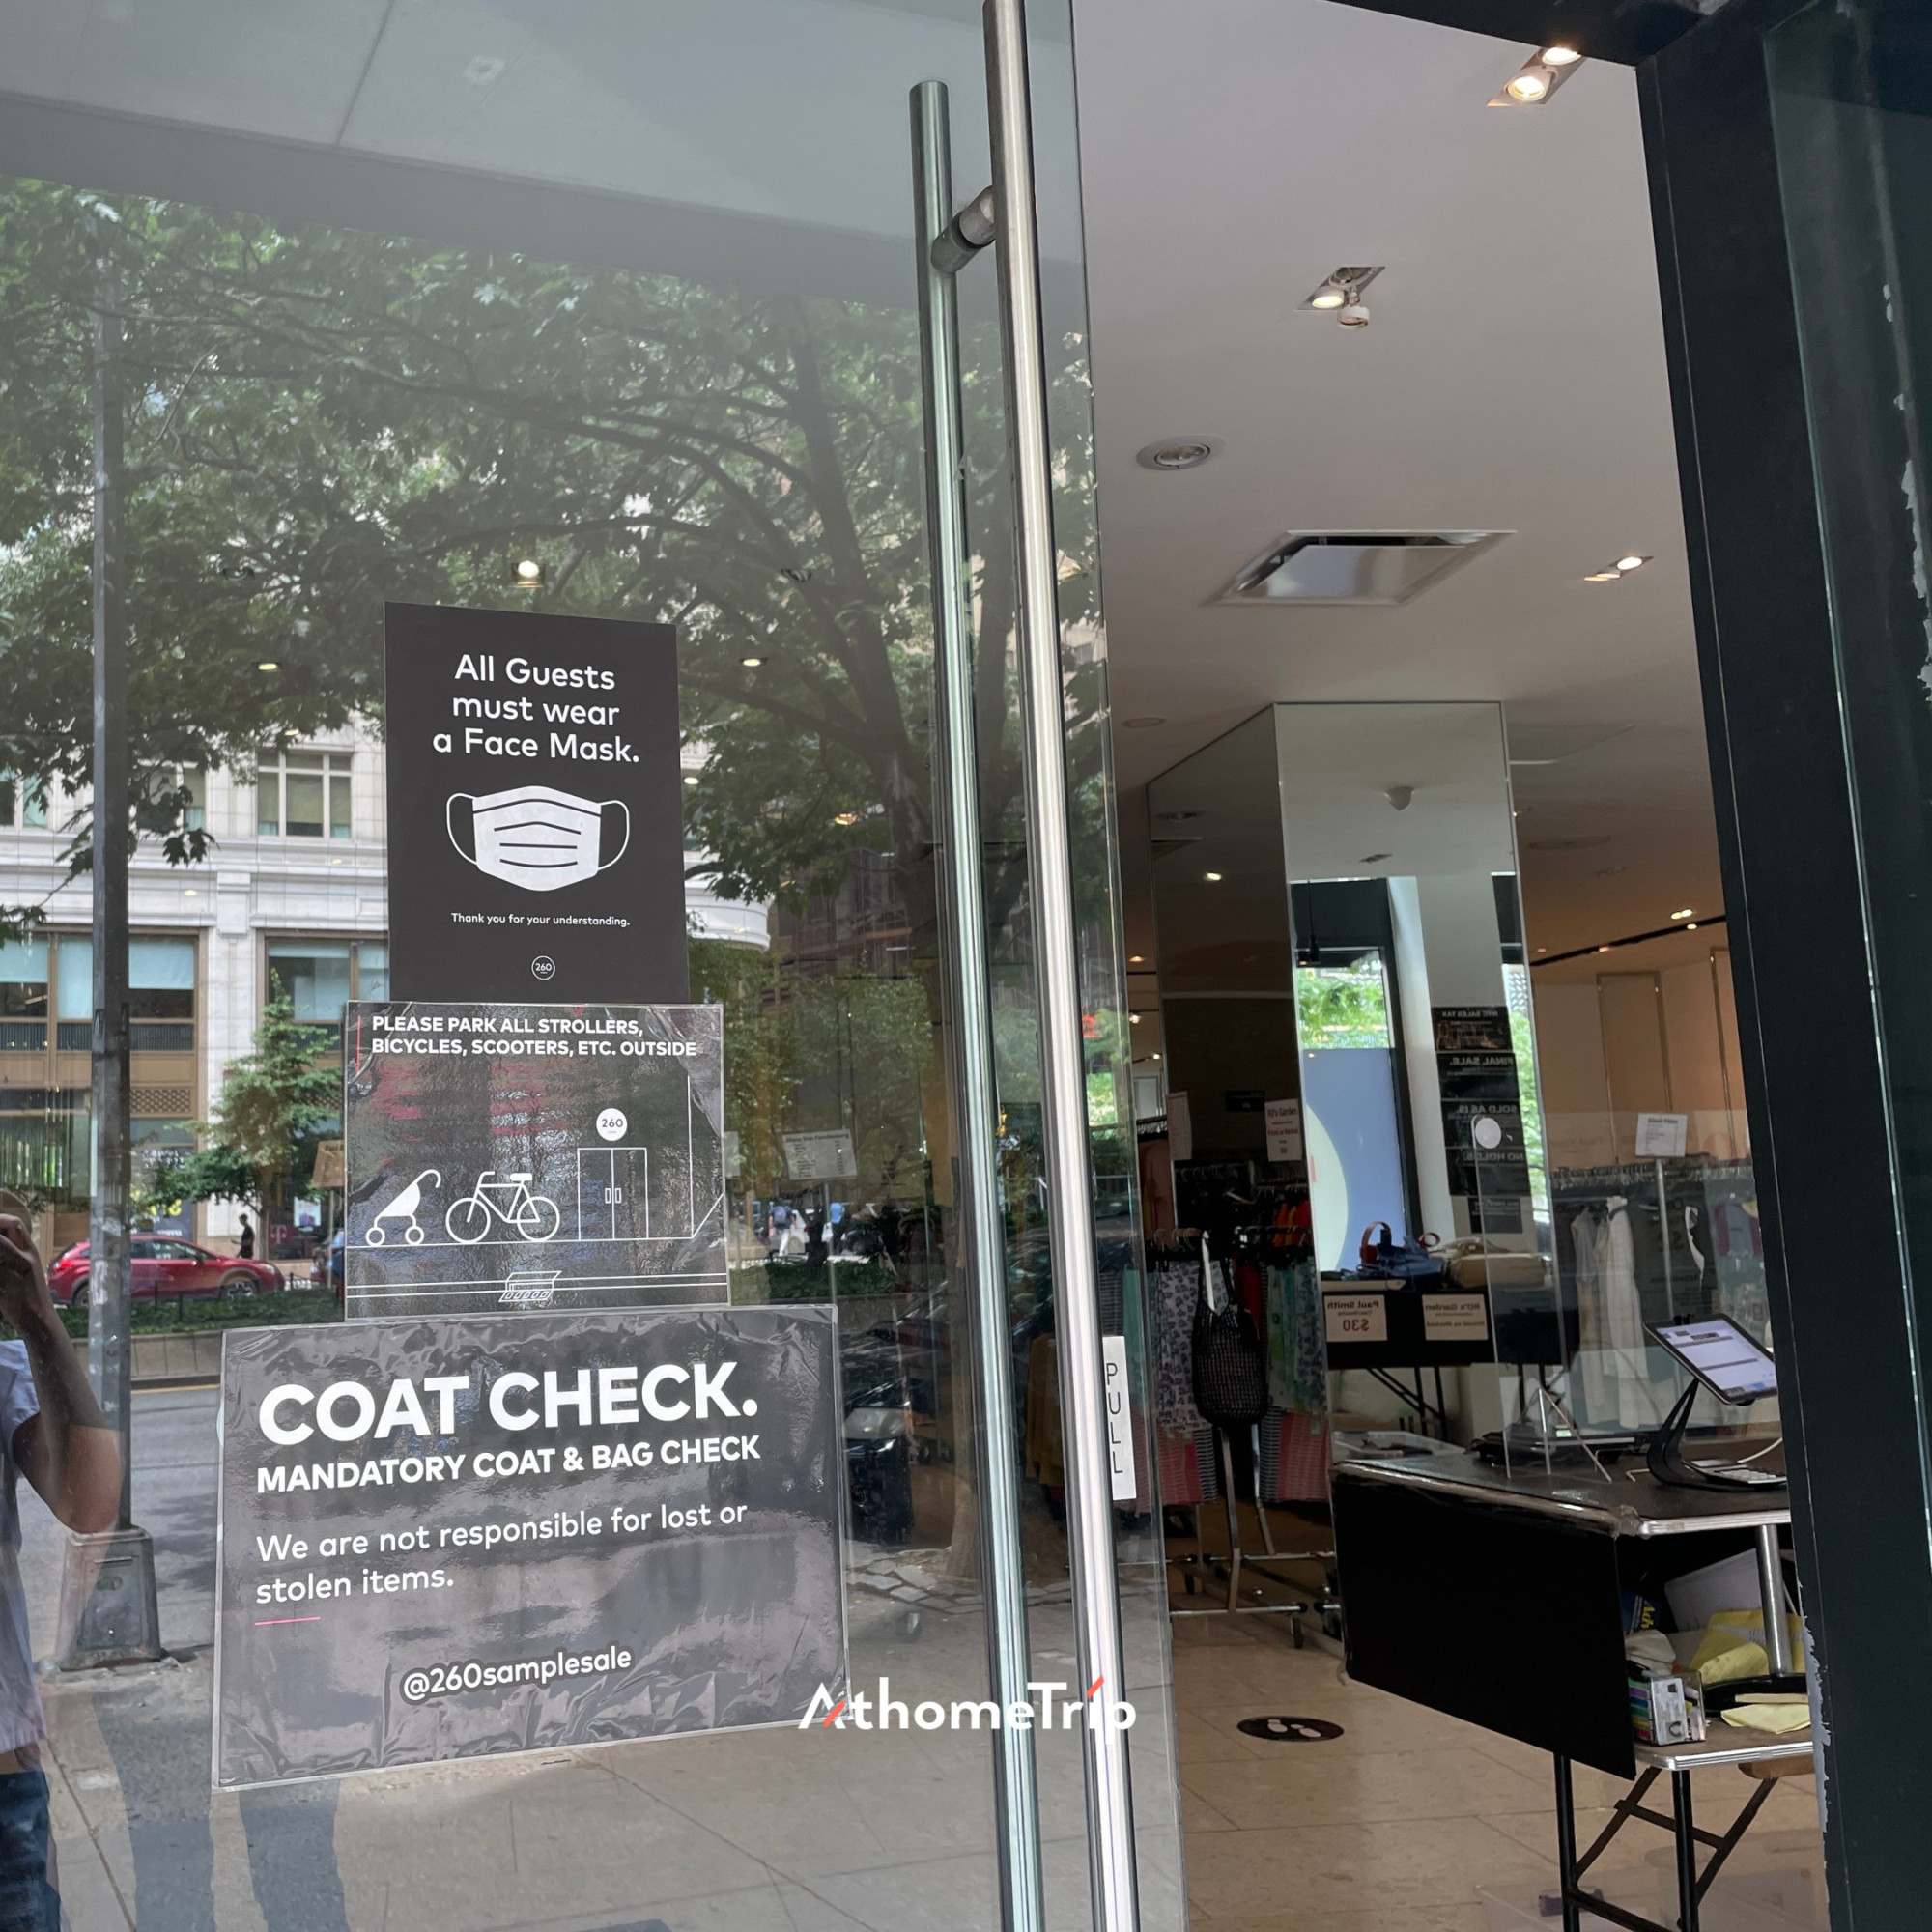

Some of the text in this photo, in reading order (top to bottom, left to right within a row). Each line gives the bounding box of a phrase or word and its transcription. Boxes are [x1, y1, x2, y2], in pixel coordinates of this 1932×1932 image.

[454, 654, 615, 690] All Guests
[452, 696, 620, 725] must wear
[432, 728, 639, 763] a Face Mask.
[450, 913, 631, 928] Thank you for your understanding.
[535, 962, 553, 973] 260
[372, 1015, 644, 1037] PLEASE PARK ALL STROLLERS,
[371, 1038, 696, 1058] BICYCLES, SCOOTERS, ETC. OUTSIDE
[601, 1118, 624, 1128] 260
[259, 1361, 758, 1445] COAT CHECK.
[1106, 1363, 1123, 1474] PULL
[257, 1435, 760, 1493] MANDATORY COAT & BAG CHECK
[256, 1504, 747, 1562] We are not responsible for lost or
[256, 1568, 454, 1605] stolen items.
[403, 1646, 633, 1702] @260samplesale
